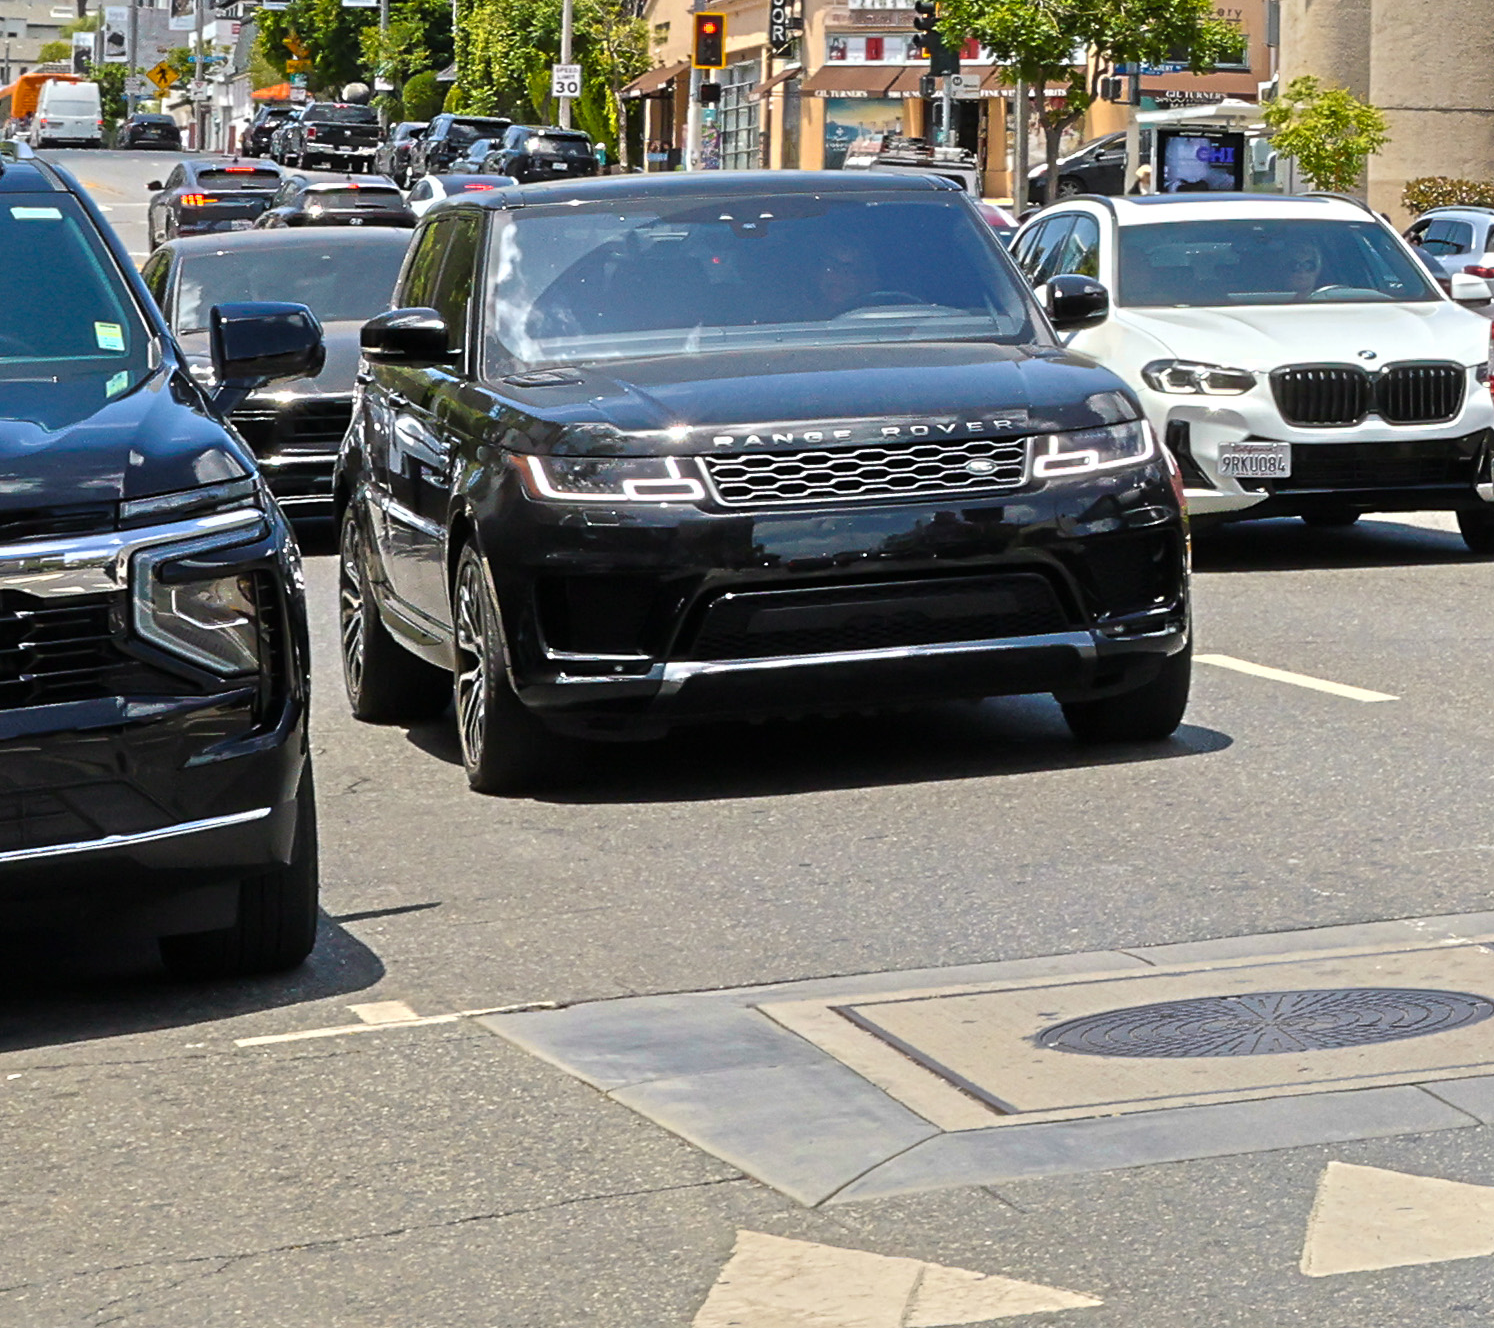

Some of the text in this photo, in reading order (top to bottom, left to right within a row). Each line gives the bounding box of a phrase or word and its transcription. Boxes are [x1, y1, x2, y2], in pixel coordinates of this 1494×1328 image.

[555, 81, 578, 93] 30
[713, 419, 1012, 448] RANGE ROVER
[1222, 456, 1286, 472] 9RKU084
